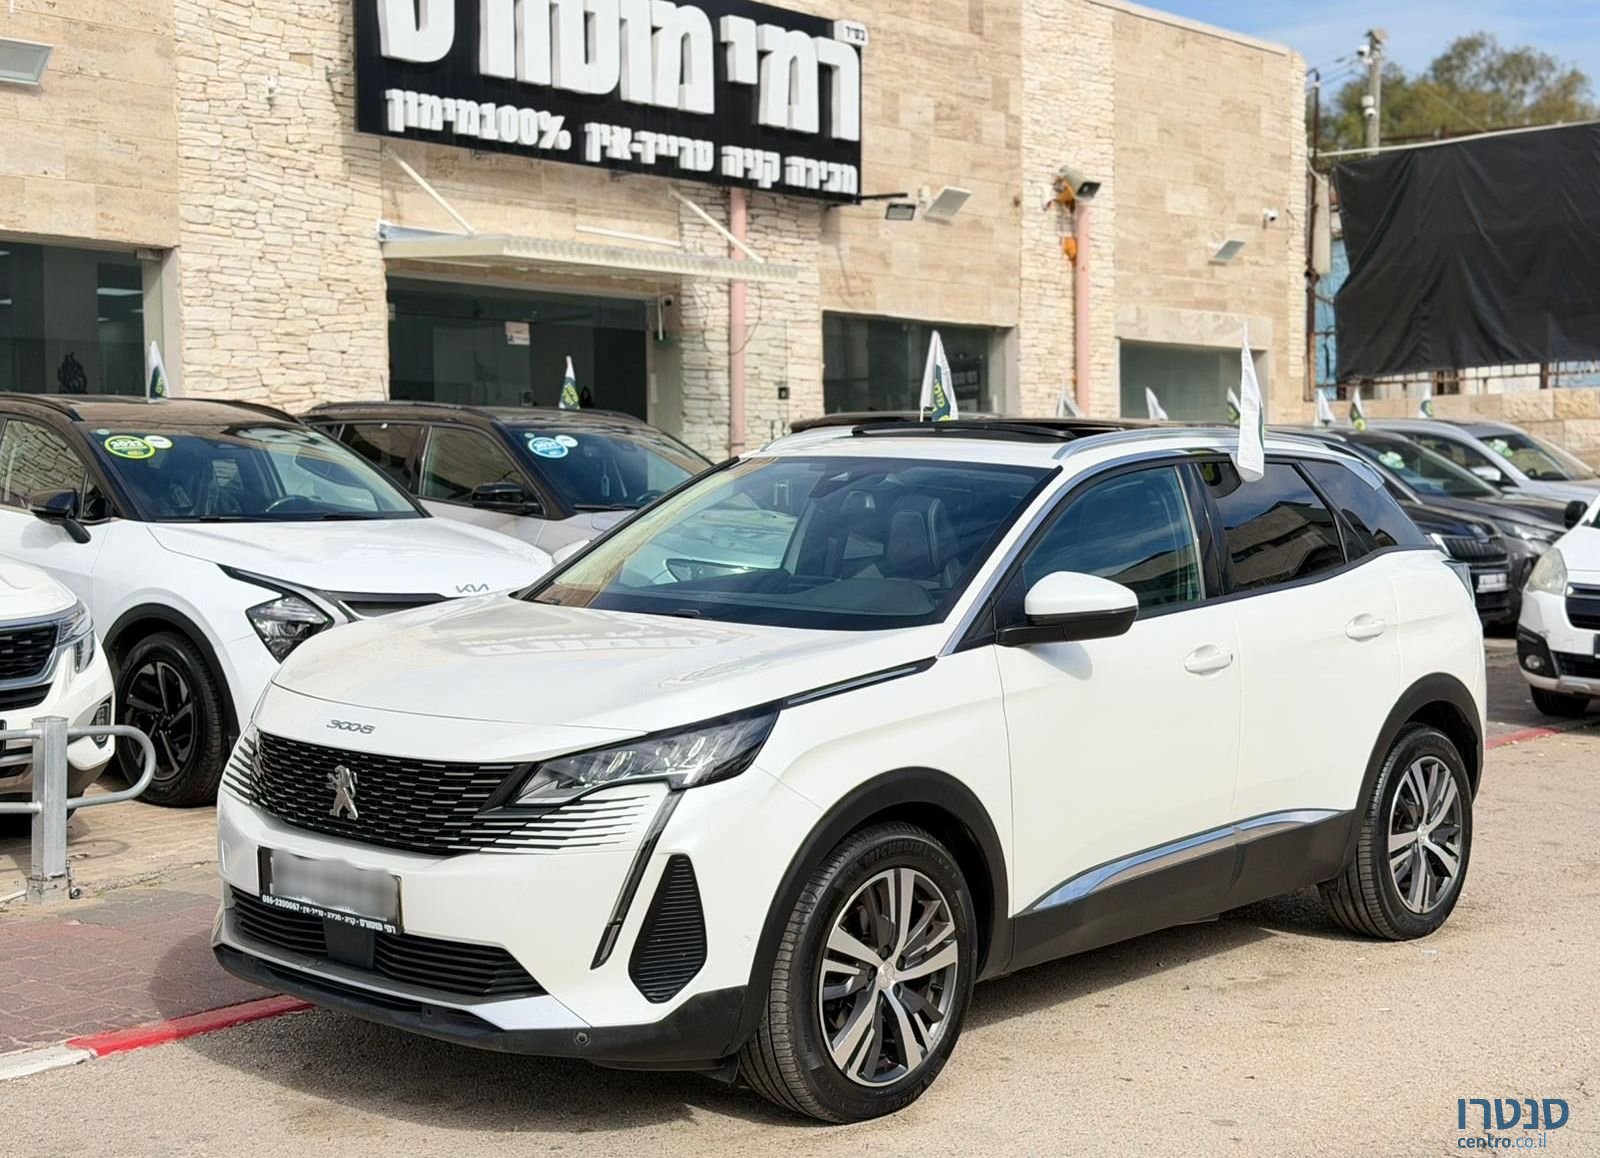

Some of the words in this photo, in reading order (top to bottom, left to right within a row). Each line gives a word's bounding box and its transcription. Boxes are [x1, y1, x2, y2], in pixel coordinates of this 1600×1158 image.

[720, 14, 861, 141] רמי
[584, 122, 714, 172] טרייד-אין
[721, 145, 780, 189] קניה
[785, 156, 858, 195] מכירה
[326, 719, 376, 734] 3008
